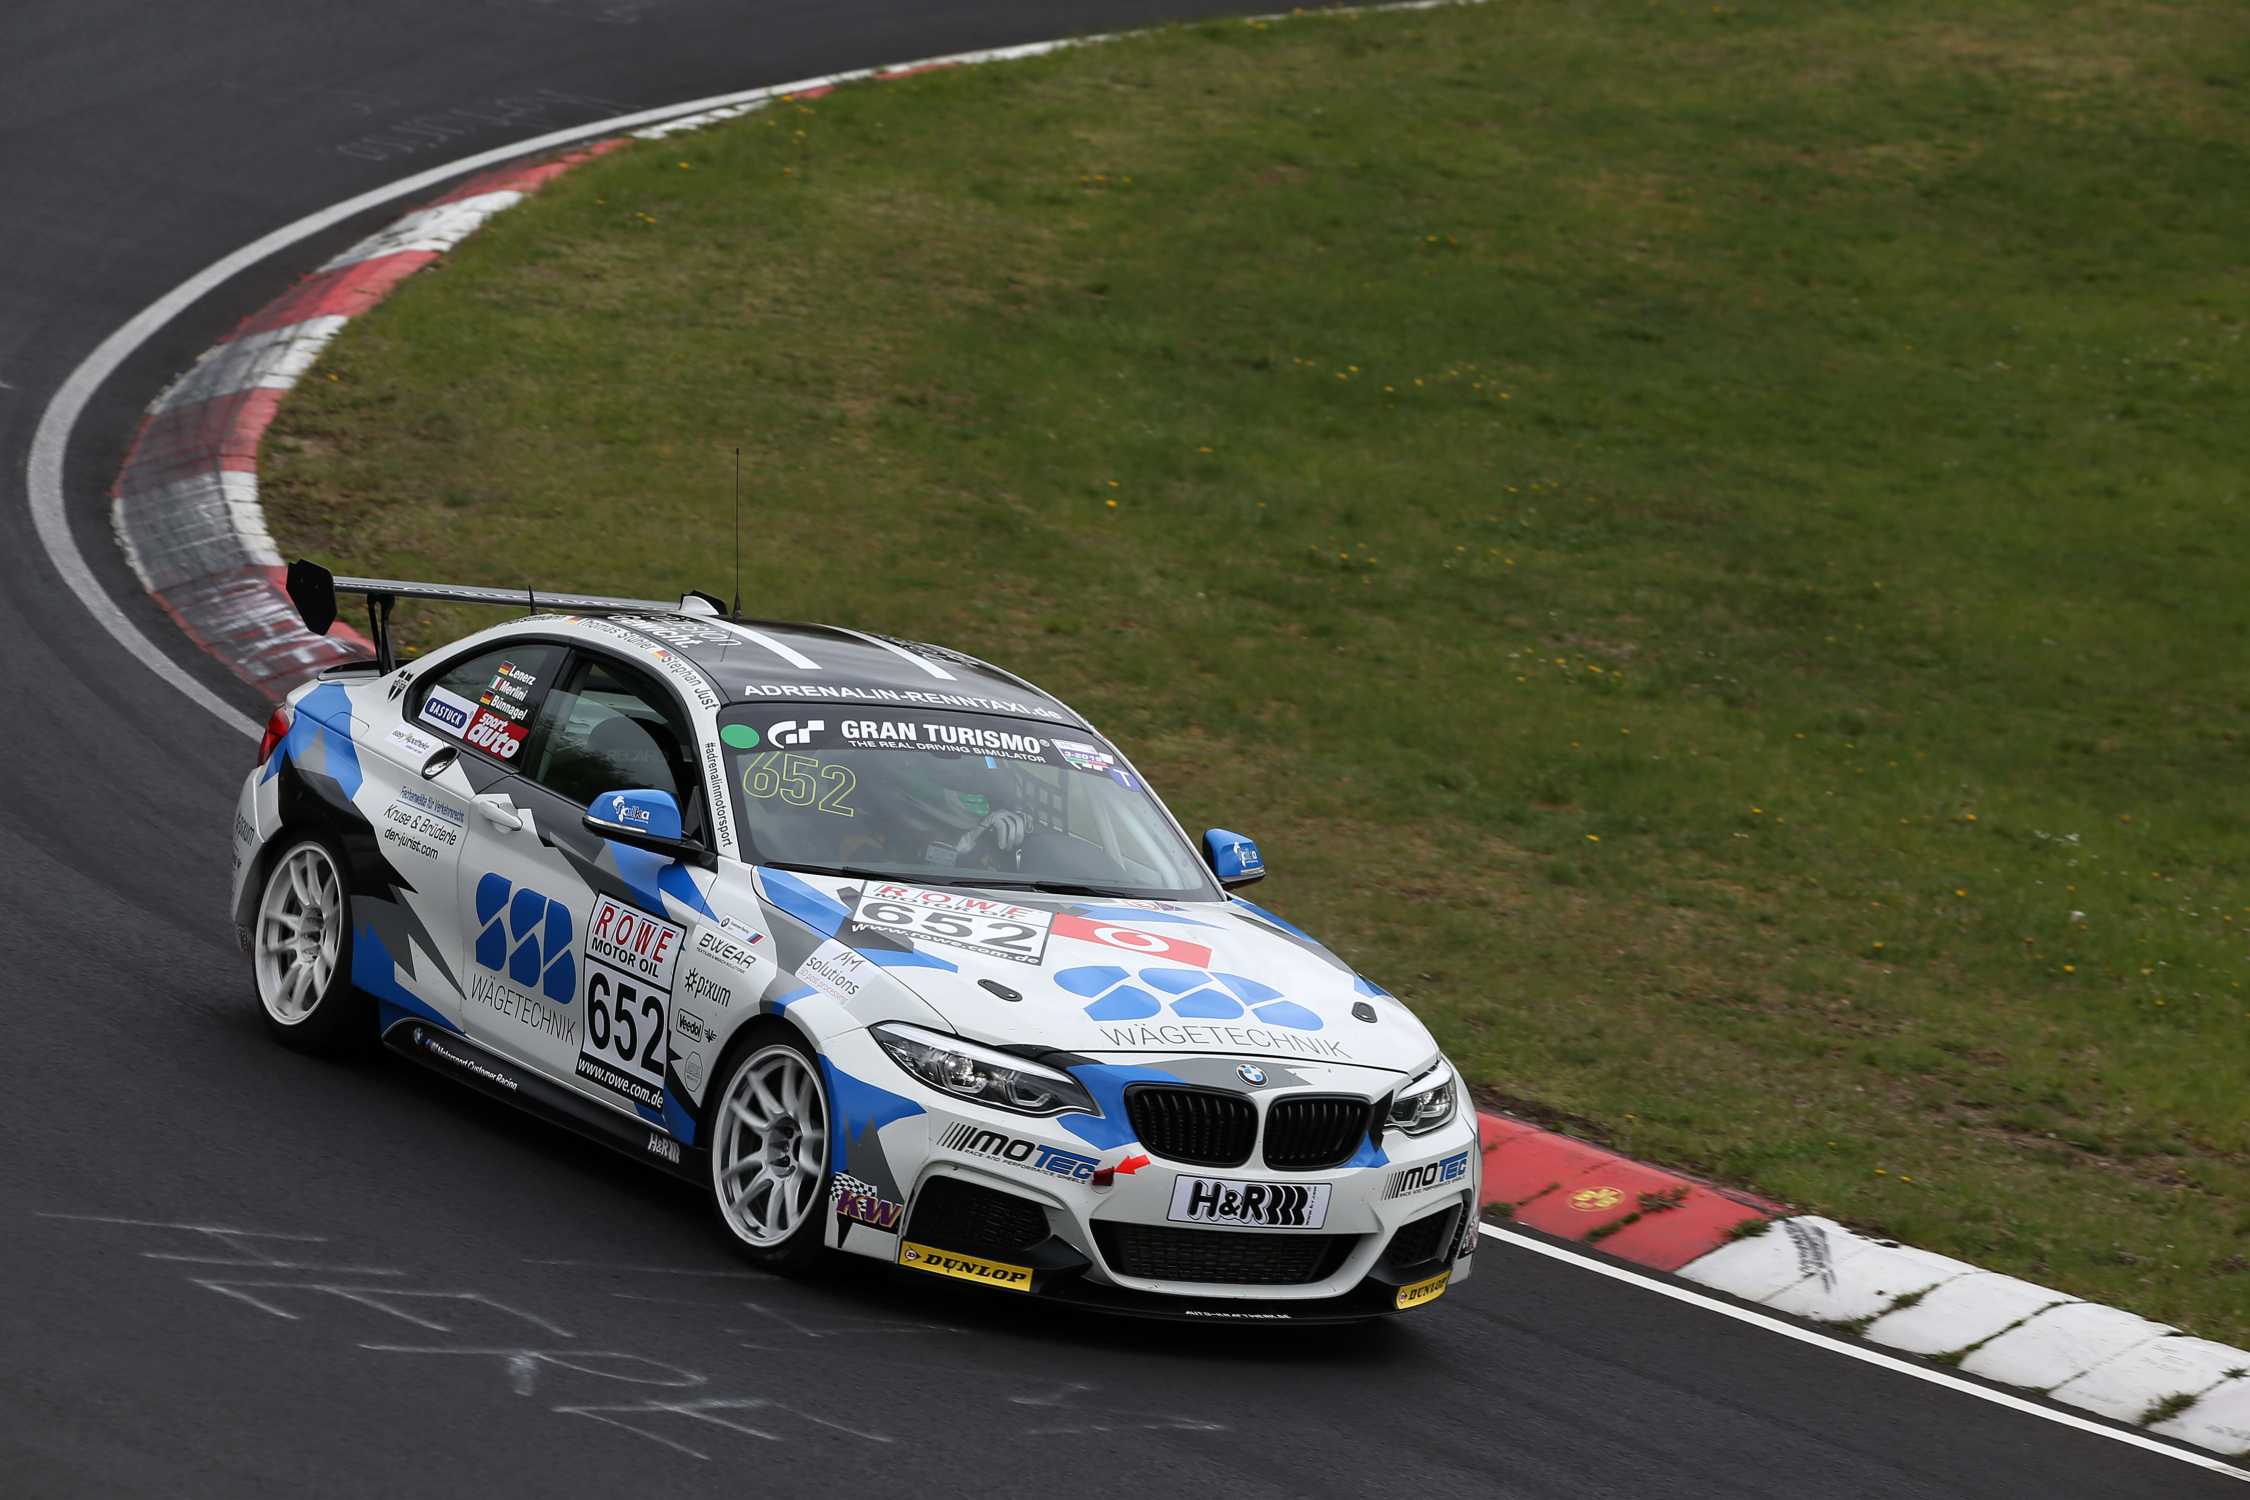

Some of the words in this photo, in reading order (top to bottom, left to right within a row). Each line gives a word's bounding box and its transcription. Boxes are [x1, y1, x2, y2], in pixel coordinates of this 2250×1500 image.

[499, 680, 529, 702] Merlini
[509, 665, 537, 686] Lenerz
[660, 656, 701, 689] Stephan
[694, 684, 720, 711] Just
[429, 702, 463, 727] BASTUCK
[490, 695, 528, 721] Bünnagel
[744, 685, 1062, 720] ADRENALIN-RENNTAXI.de
[479, 712, 509, 732] sport
[841, 720, 917, 741] GRAN
[467, 723, 520, 759] auto
[848, 740, 877, 749] THE
[880, 741, 914, 750] REAL
[917, 742, 971, 754] DRIVING
[973, 746, 1046, 764] SIMULATOR
[705, 741, 733, 848] #adrenalinmotorsport
[742, 751, 857, 818] 652
[1113, 768, 1129, 787] T
[384, 803, 411, 826] Kruse
[410, 814, 423, 830] &
[419, 818, 457, 846] Brüderle
[384, 827, 439, 860] der-jurist.com
[875, 884, 1037, 916] ROWE
[875, 893, 967, 913] MOTOR
[594, 902, 674, 963] ROWE
[851, 922, 1040, 964] www.rowe.com.de
[862, 902, 1038, 952] 652
[592, 938, 635, 971] MOTOR
[639, 957, 661, 978] OIL
[699, 932, 756, 969] BWEAR
[806, 956, 859, 996] solutions
[471, 973, 577, 1046] WÄGETECHNIK
[588, 972, 667, 1078] 652
[679, 1013, 702, 1038] Veedol
[1101, 1022, 1353, 1060] WÄGETECHNIK
[467, 1059, 498, 1082] Customer
[495, 1071, 518, 1092] Racing
[577, 1057, 664, 1109] www.rowe.com.de
[648, 1133, 670, 1157] H&R
[964, 1149, 985, 1159] RACE
[837, 1188, 904, 1229] KW
[1188, 1180, 1269, 1224] H&R
[923, 1253, 1027, 1283] DUNLOP
